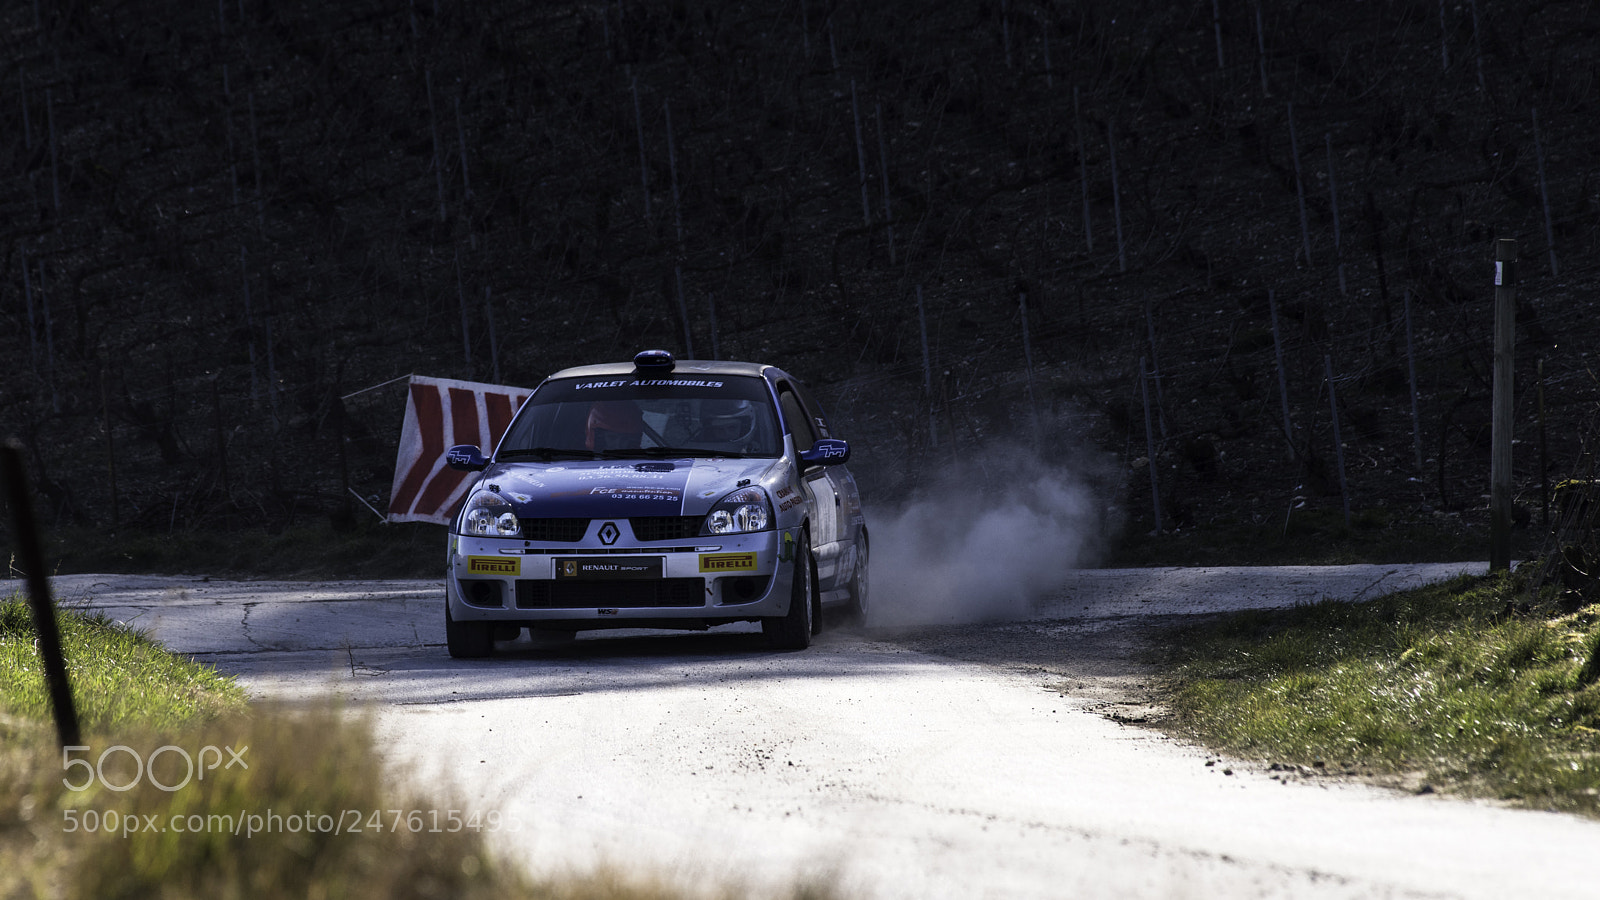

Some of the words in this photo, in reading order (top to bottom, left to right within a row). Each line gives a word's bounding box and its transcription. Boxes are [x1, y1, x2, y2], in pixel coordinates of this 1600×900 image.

[575, 380, 626, 390] VARLET
[629, 380, 724, 388] AUTOMOBILES
[471, 559, 516, 572] PIRELLI
[703, 555, 752, 569] PIRELLI
